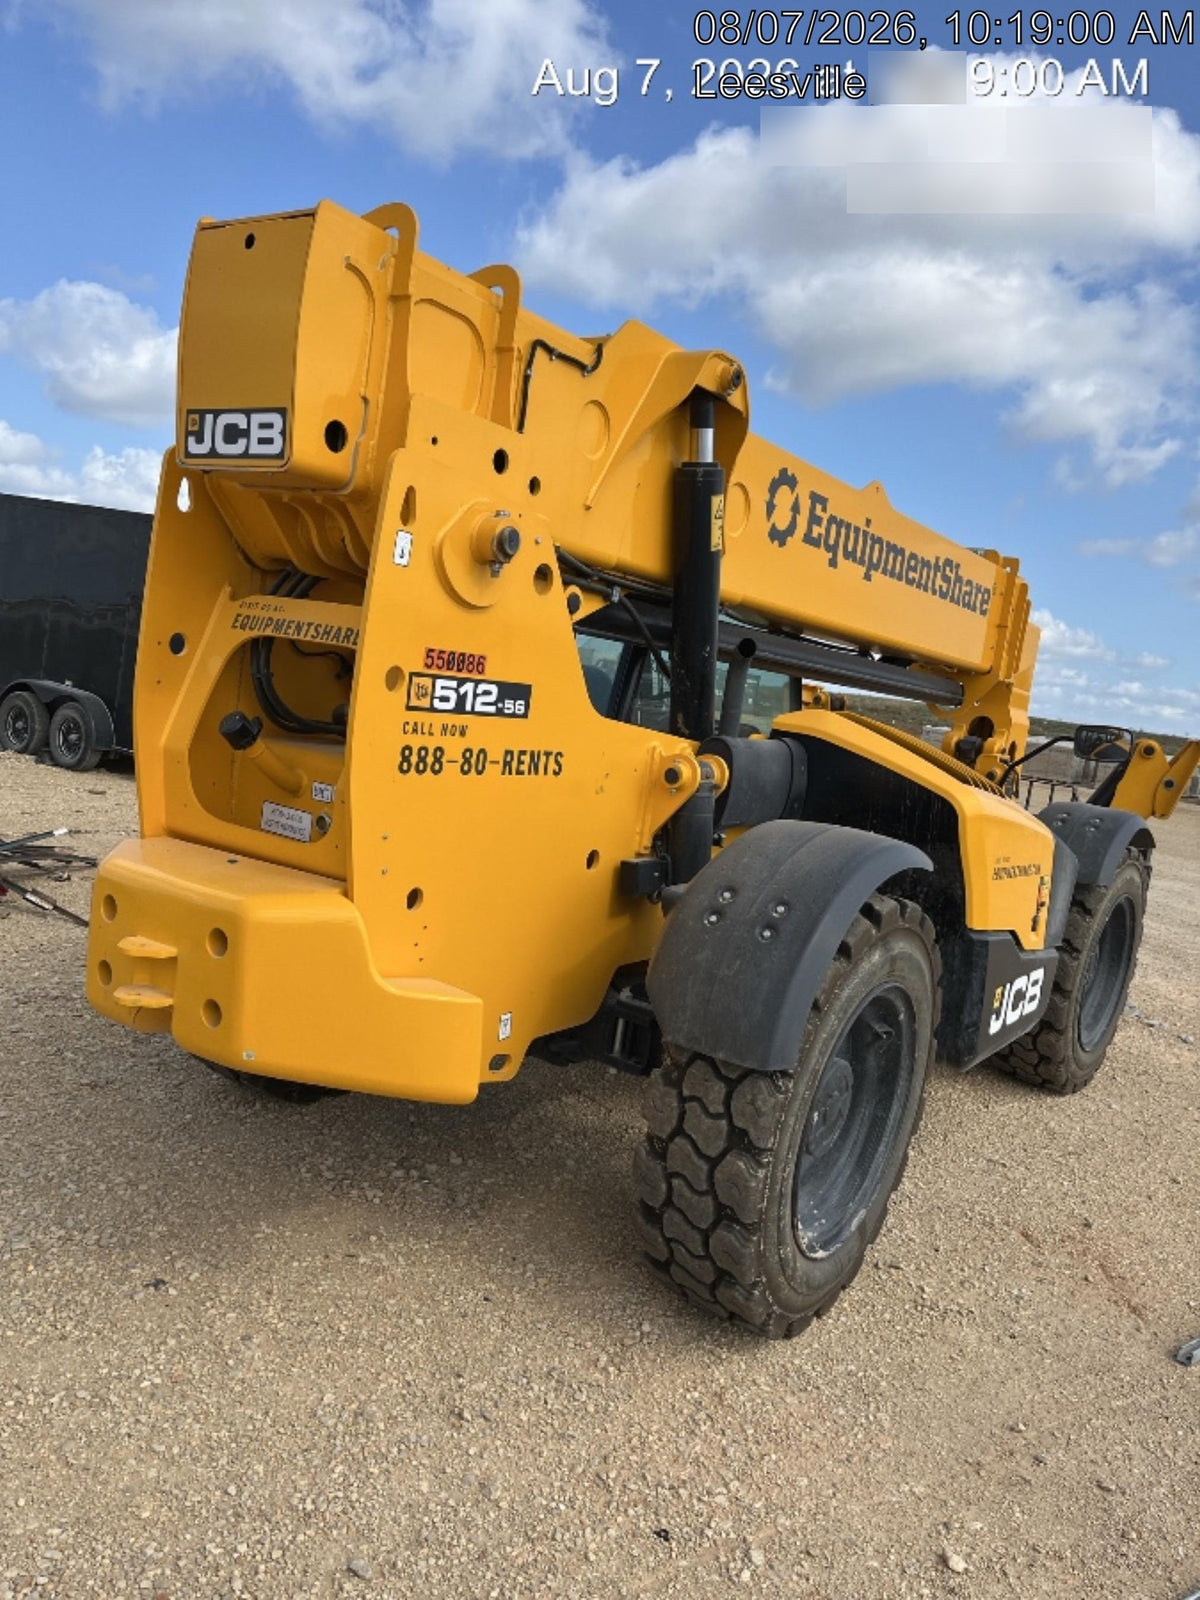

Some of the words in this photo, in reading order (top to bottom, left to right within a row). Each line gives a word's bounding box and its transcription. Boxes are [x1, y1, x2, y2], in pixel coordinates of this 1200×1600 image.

[187, 412, 284, 455] JCB
[802, 490, 991, 616] EquipmentShare
[424, 647, 487, 674] 550086
[402, 721, 435, 737] CALL
[440, 723, 469, 738] NOW
[398, 744, 564, 777] 888-80-RENTS
[988, 966, 1045, 1036] JCB
